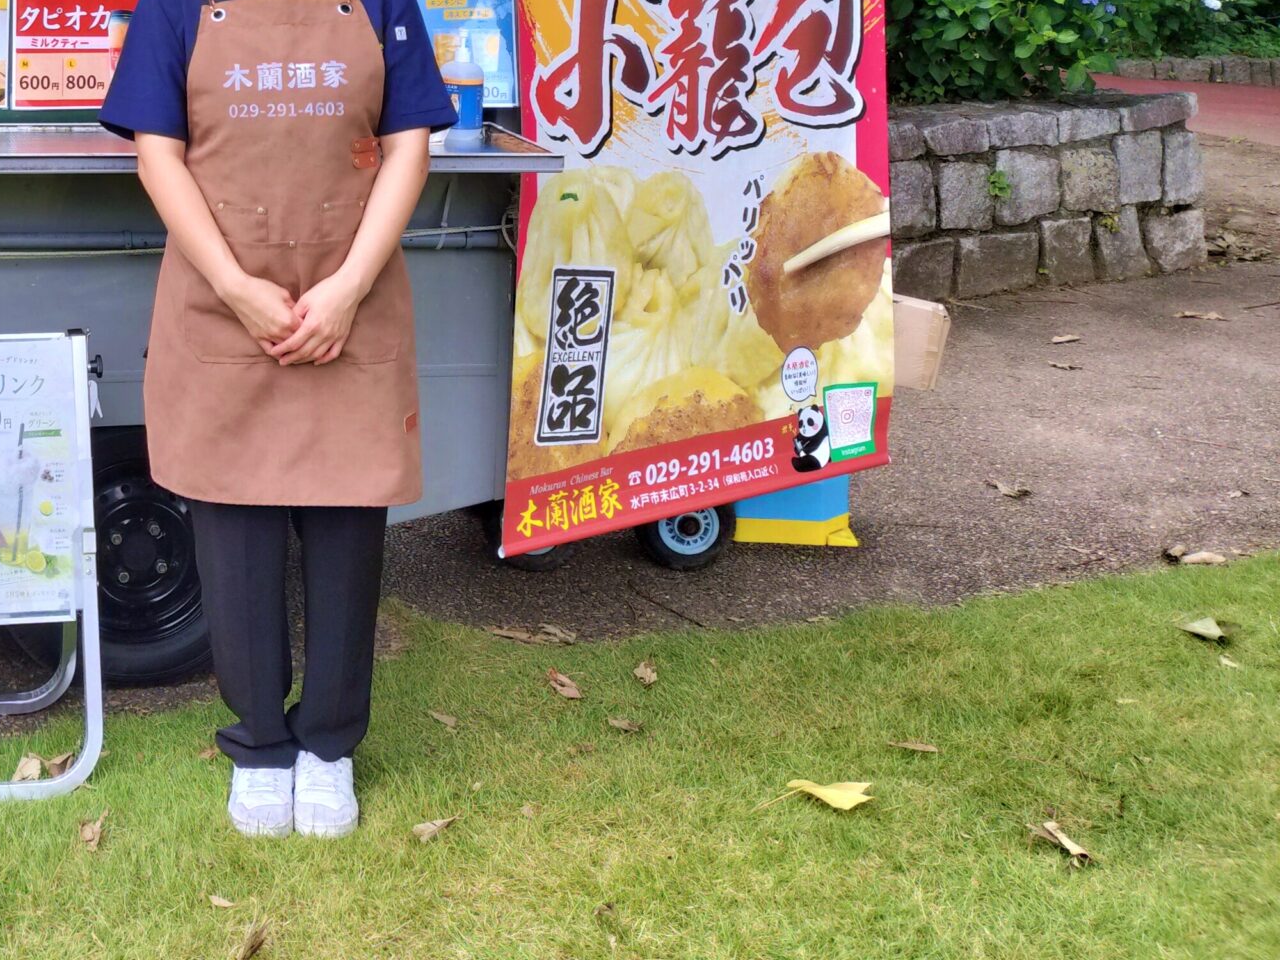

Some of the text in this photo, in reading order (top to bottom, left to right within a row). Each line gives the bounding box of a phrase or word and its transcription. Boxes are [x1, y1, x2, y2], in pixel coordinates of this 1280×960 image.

[20, 4, 111, 32] タピオカ
[30, 38, 89, 48] ミルクティー
[20, 74, 105, 90] 600円 800円
[223, 60, 349, 91] 木蘭酒家
[228, 102, 345, 118] 029-291-4603
[722, 174, 765, 315] パリッパリ
[546, 277, 604, 432] 絶品
[552, 350, 601, 363] EXCELLENT
[645, 437, 775, 486] 029-291-4603
[841, 445, 867, 456] Instagram
[529, 467, 614, 496] Mokuran Chinese Bar
[516, 478, 623, 538] 木蘭酒家
